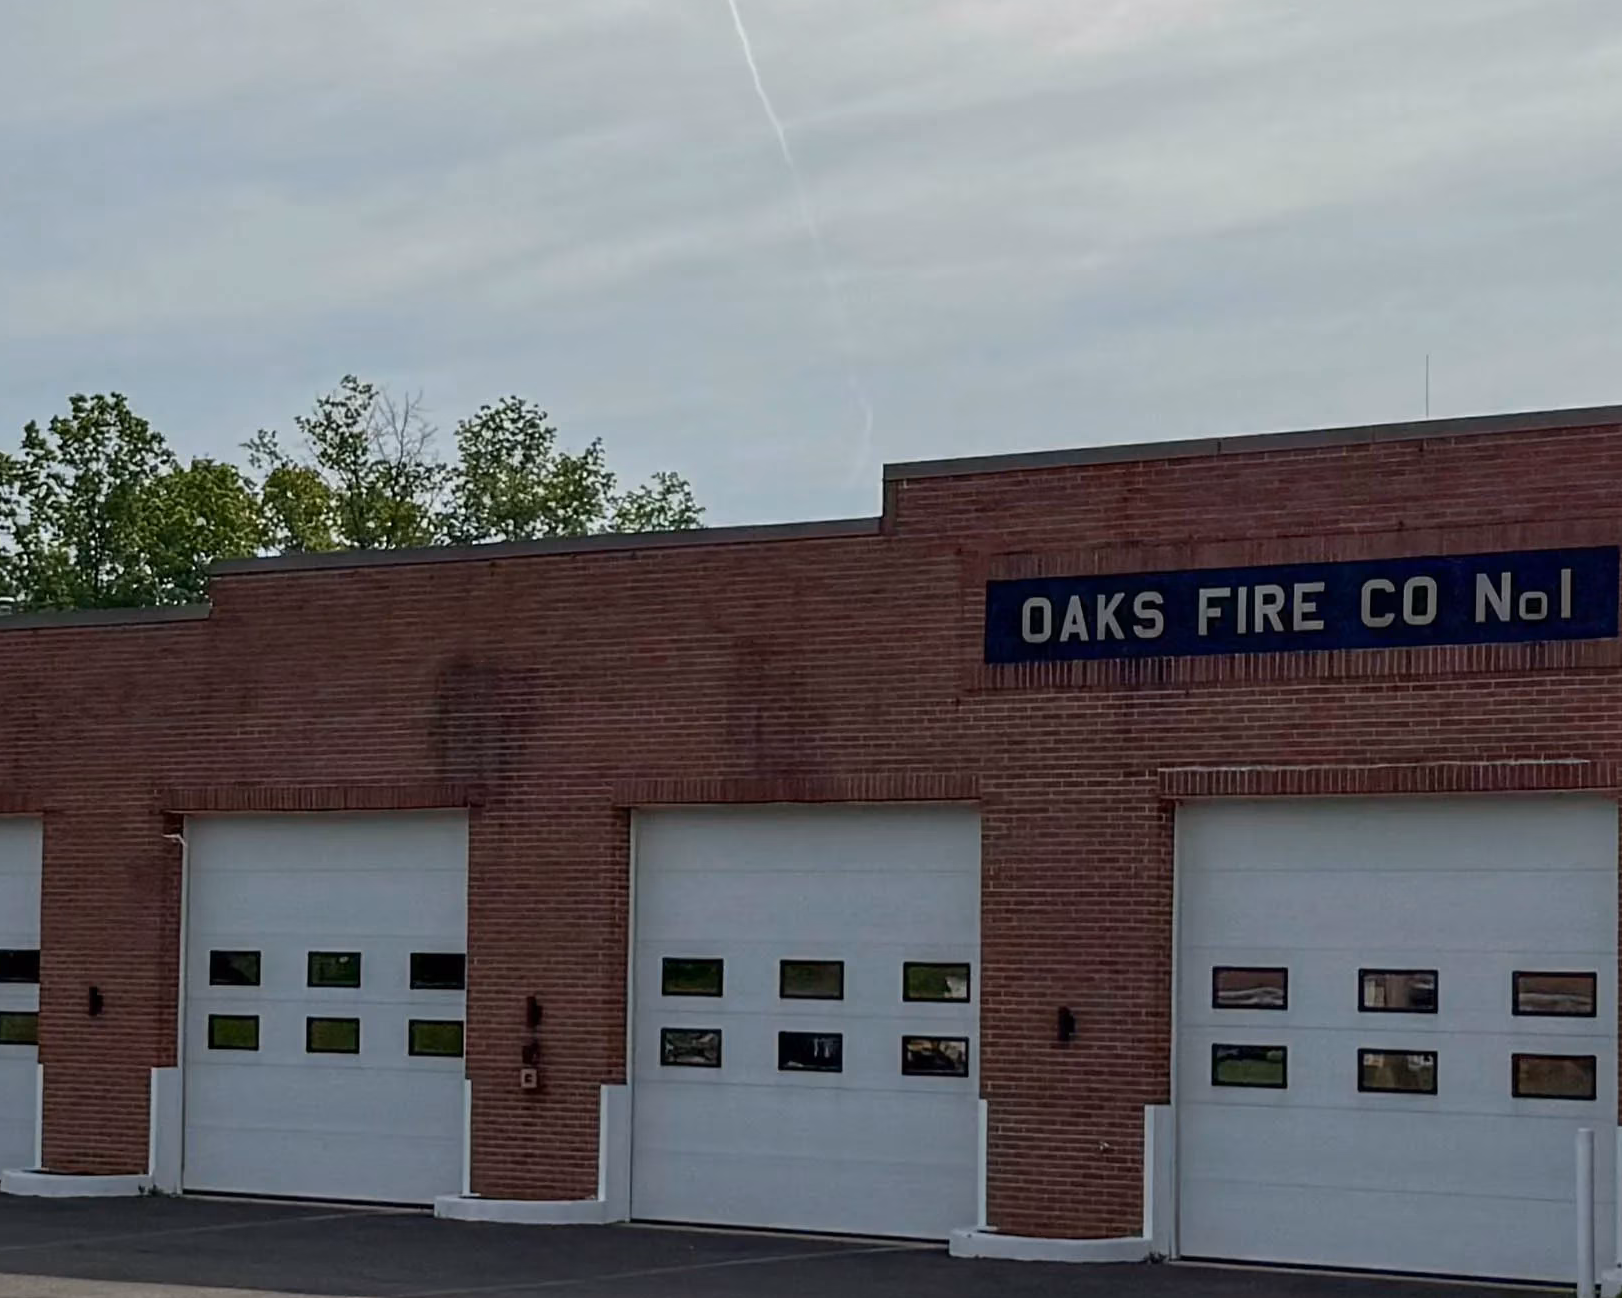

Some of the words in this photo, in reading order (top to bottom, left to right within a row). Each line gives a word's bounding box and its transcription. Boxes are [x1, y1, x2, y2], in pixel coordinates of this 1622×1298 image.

[1021, 591, 1165, 644] OAKS
[1197, 581, 1326, 636] FIRE
[1360, 575, 1438, 628] CO
